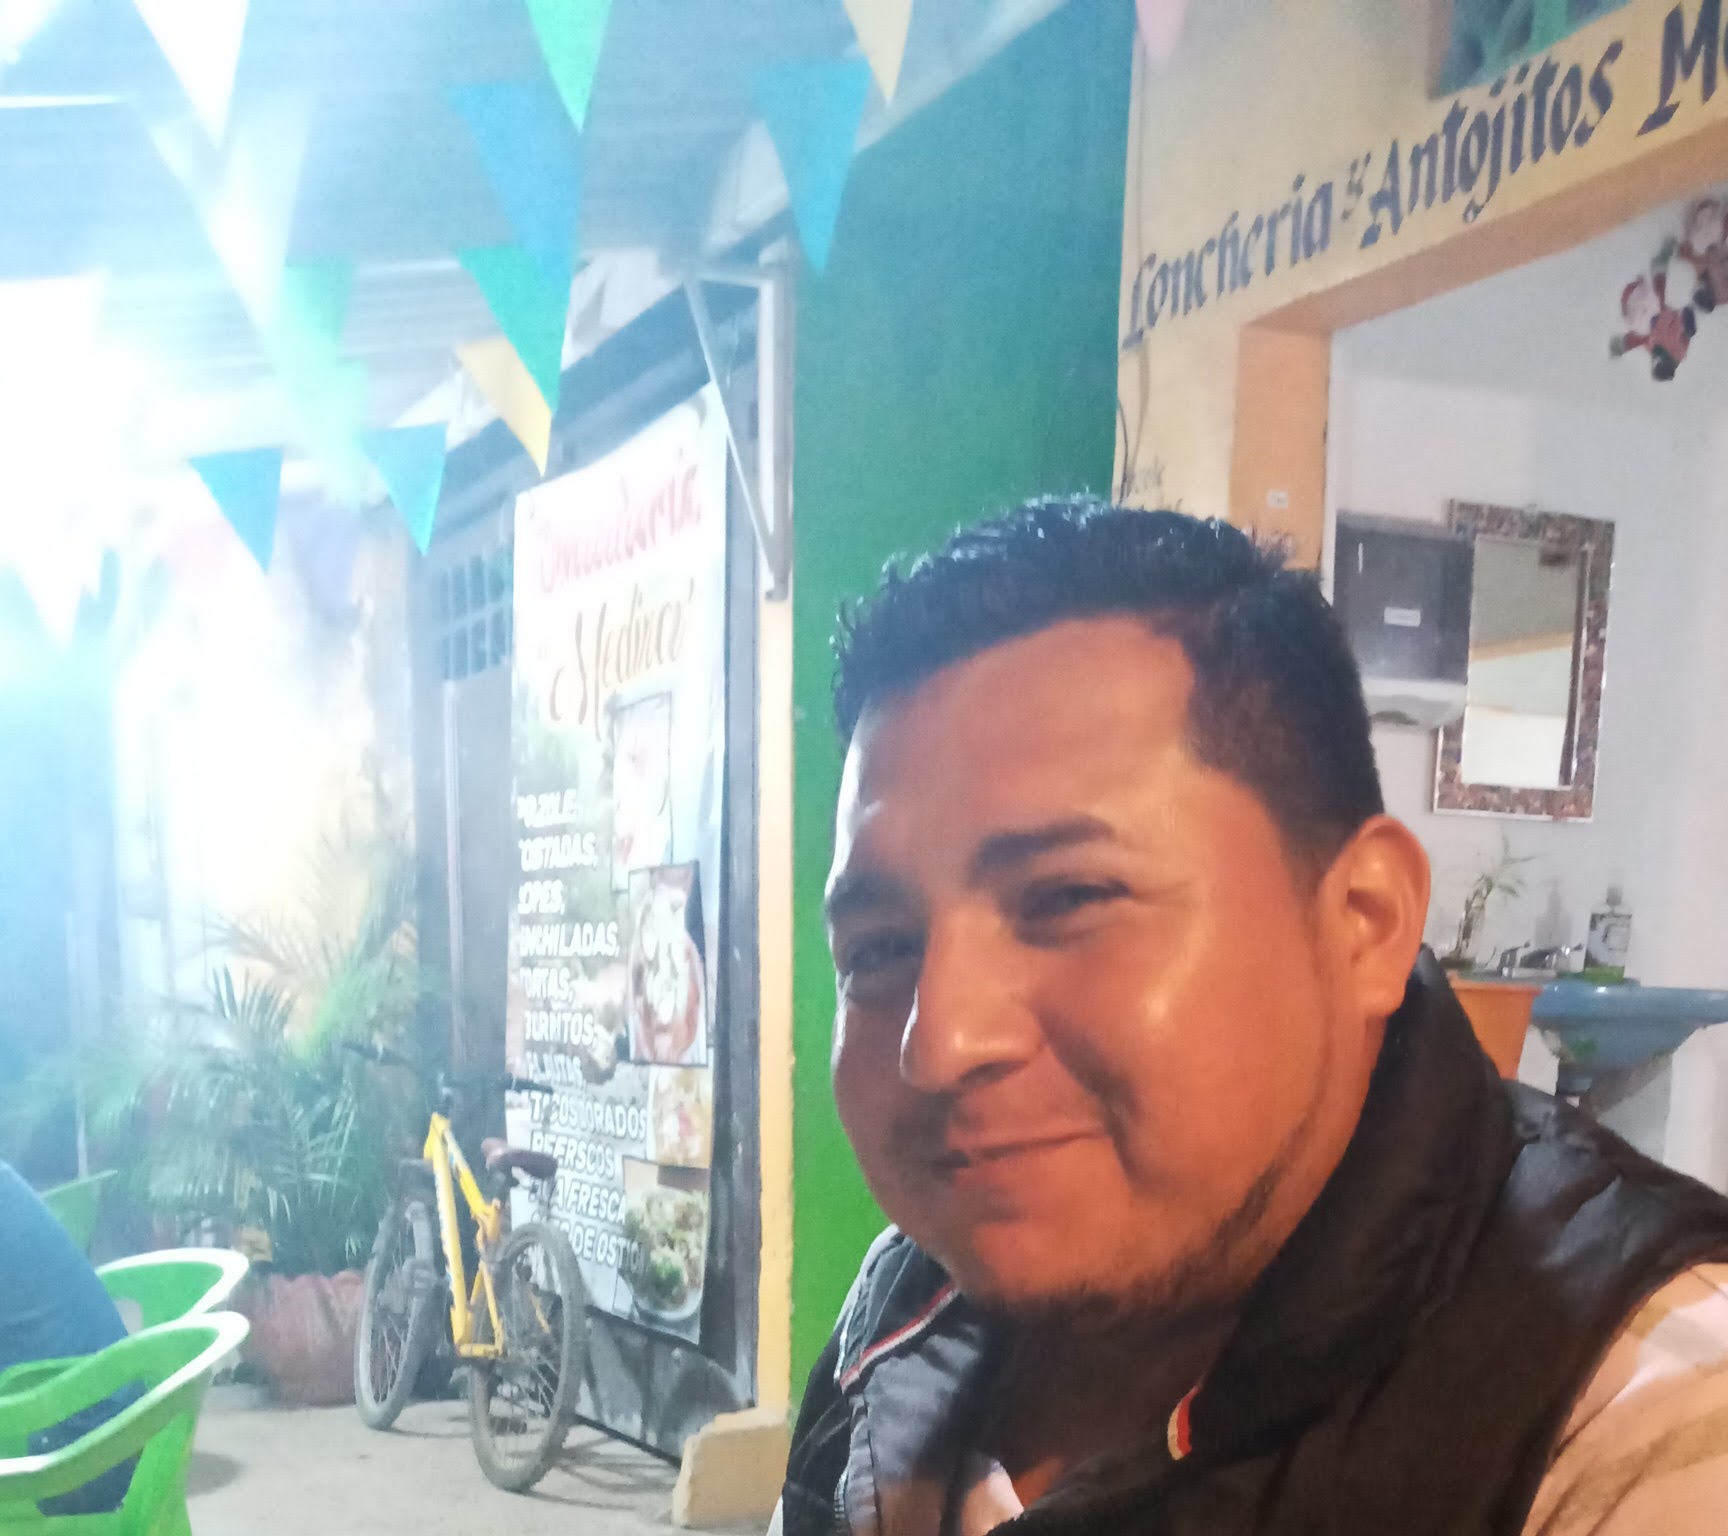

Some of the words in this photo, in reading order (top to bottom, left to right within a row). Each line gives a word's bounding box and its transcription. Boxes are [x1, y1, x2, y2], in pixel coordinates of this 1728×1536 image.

[1360, 40, 1624, 250] Antojitos
[1637, 0, 1728, 137] M
[566, 1179, 625, 1225] FRESCA
[572, 1223, 595, 1260] DE
